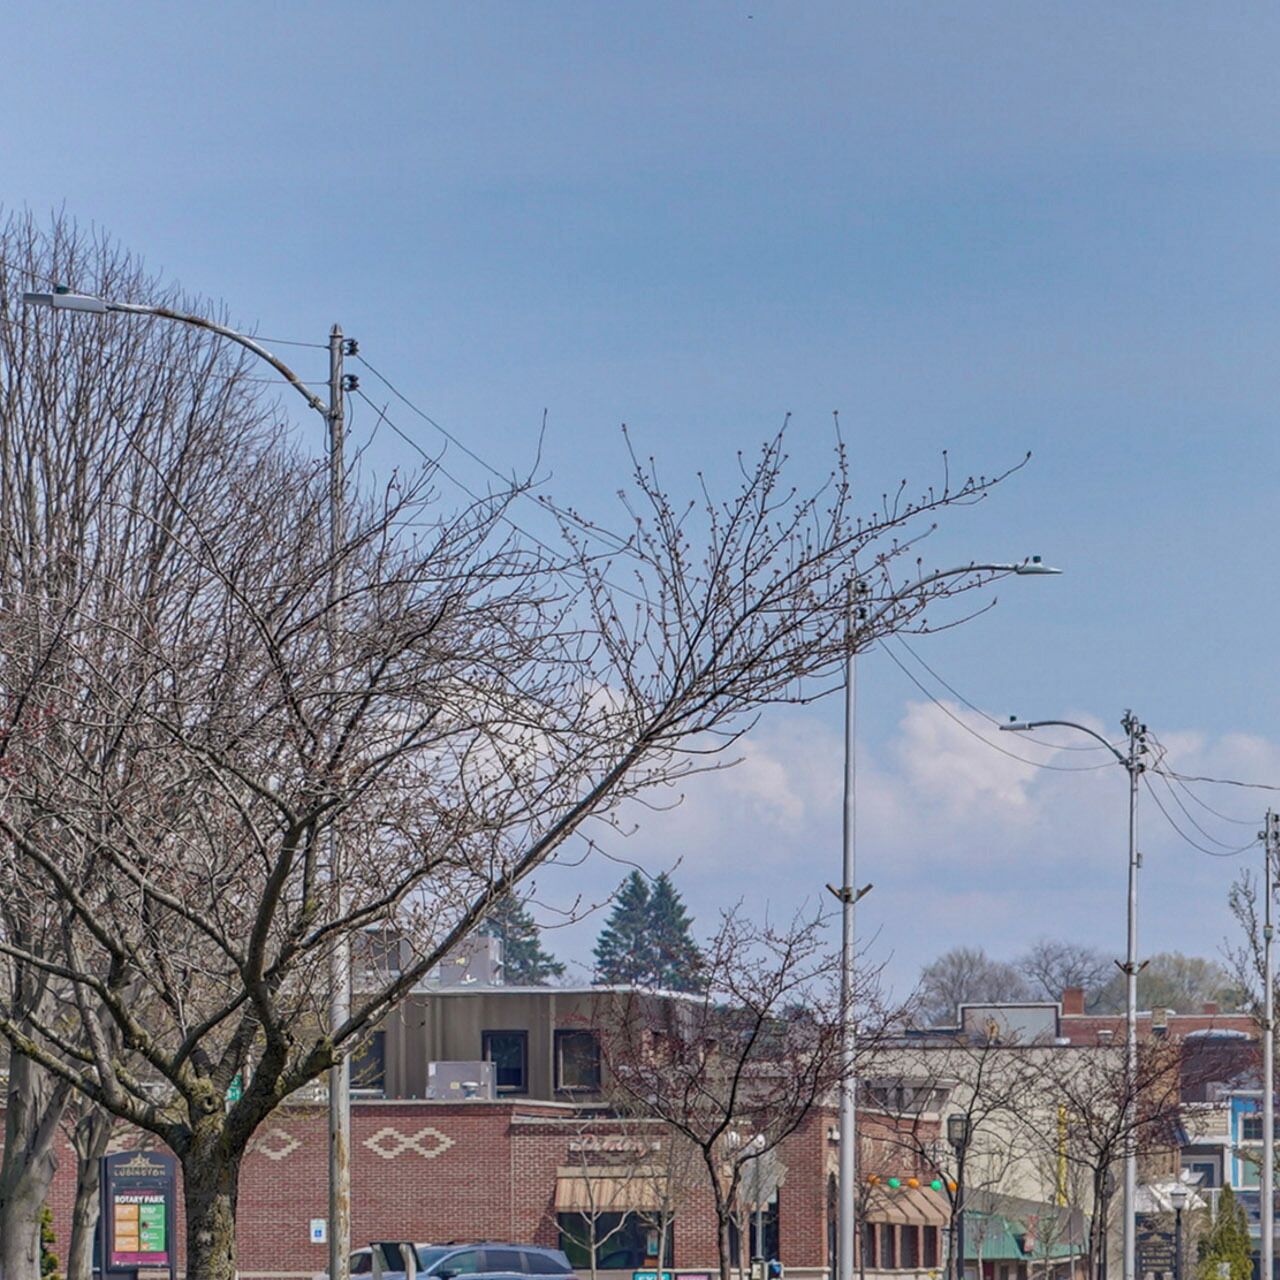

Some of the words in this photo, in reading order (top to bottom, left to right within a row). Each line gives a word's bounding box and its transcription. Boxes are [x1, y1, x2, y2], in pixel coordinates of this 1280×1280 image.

[114, 1168, 166, 1177] LUDINGTON
[114, 1195, 144, 1204] ROTARY
[144, 1195, 165, 1203] PARK
